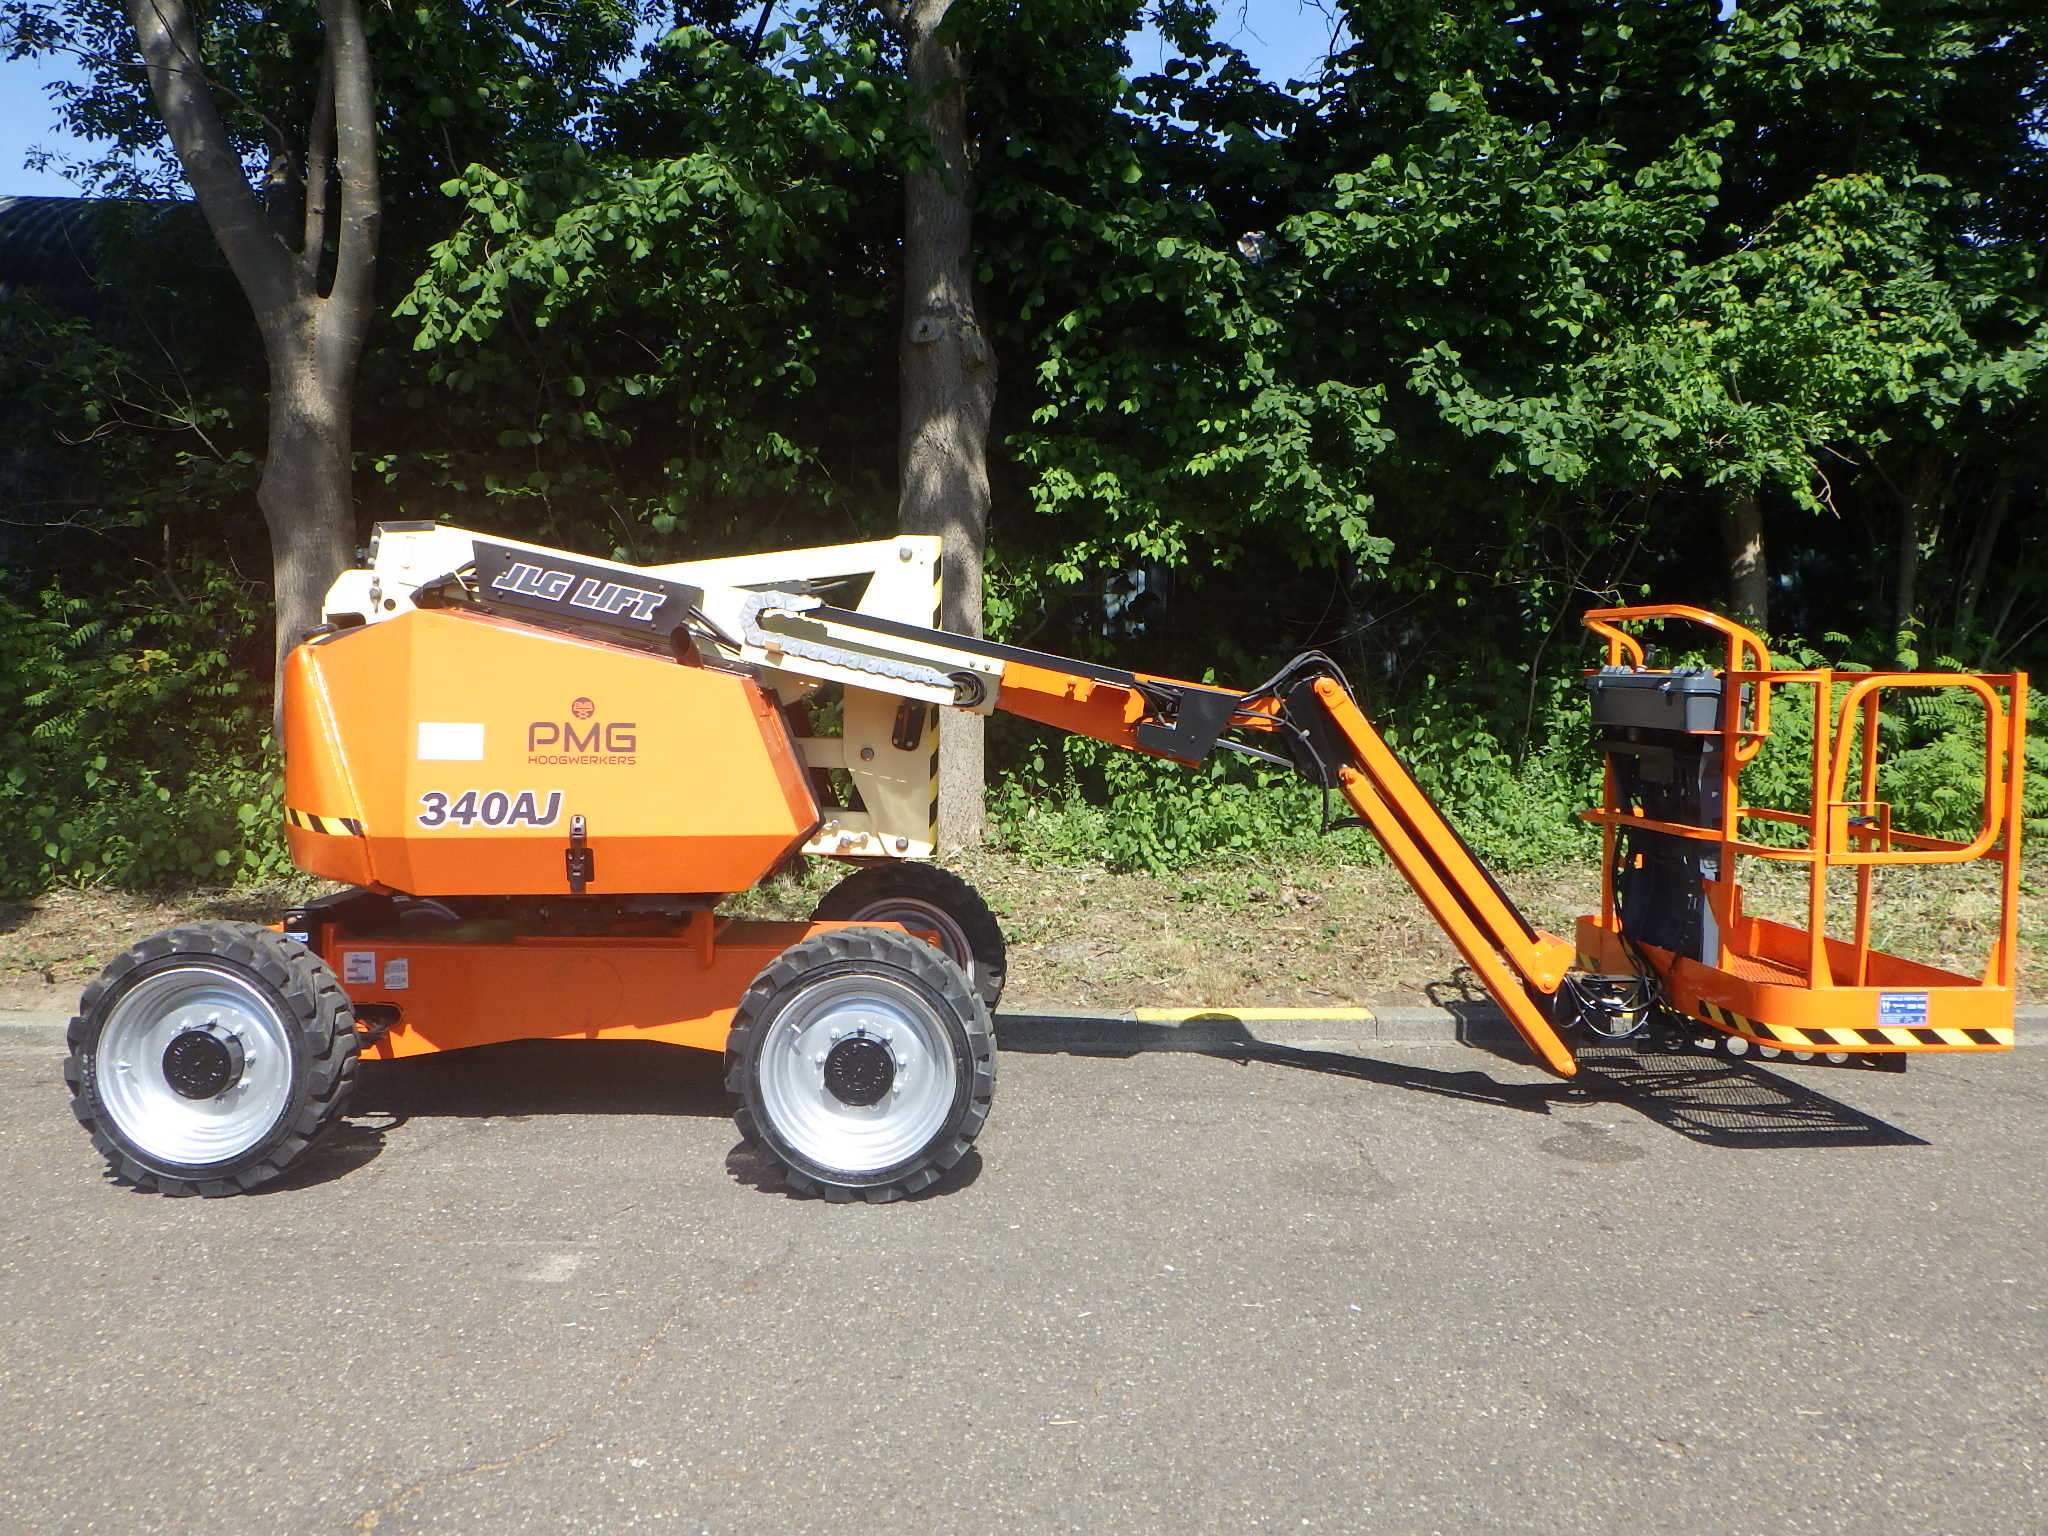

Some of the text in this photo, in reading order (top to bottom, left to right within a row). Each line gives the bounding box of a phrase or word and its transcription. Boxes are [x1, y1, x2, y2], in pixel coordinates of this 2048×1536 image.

[492, 562, 667, 621] JLG LIFT
[528, 722, 636, 752] PMG
[528, 755, 636, 765] HOOGWERKERS
[418, 790, 563, 829] 340AJ
